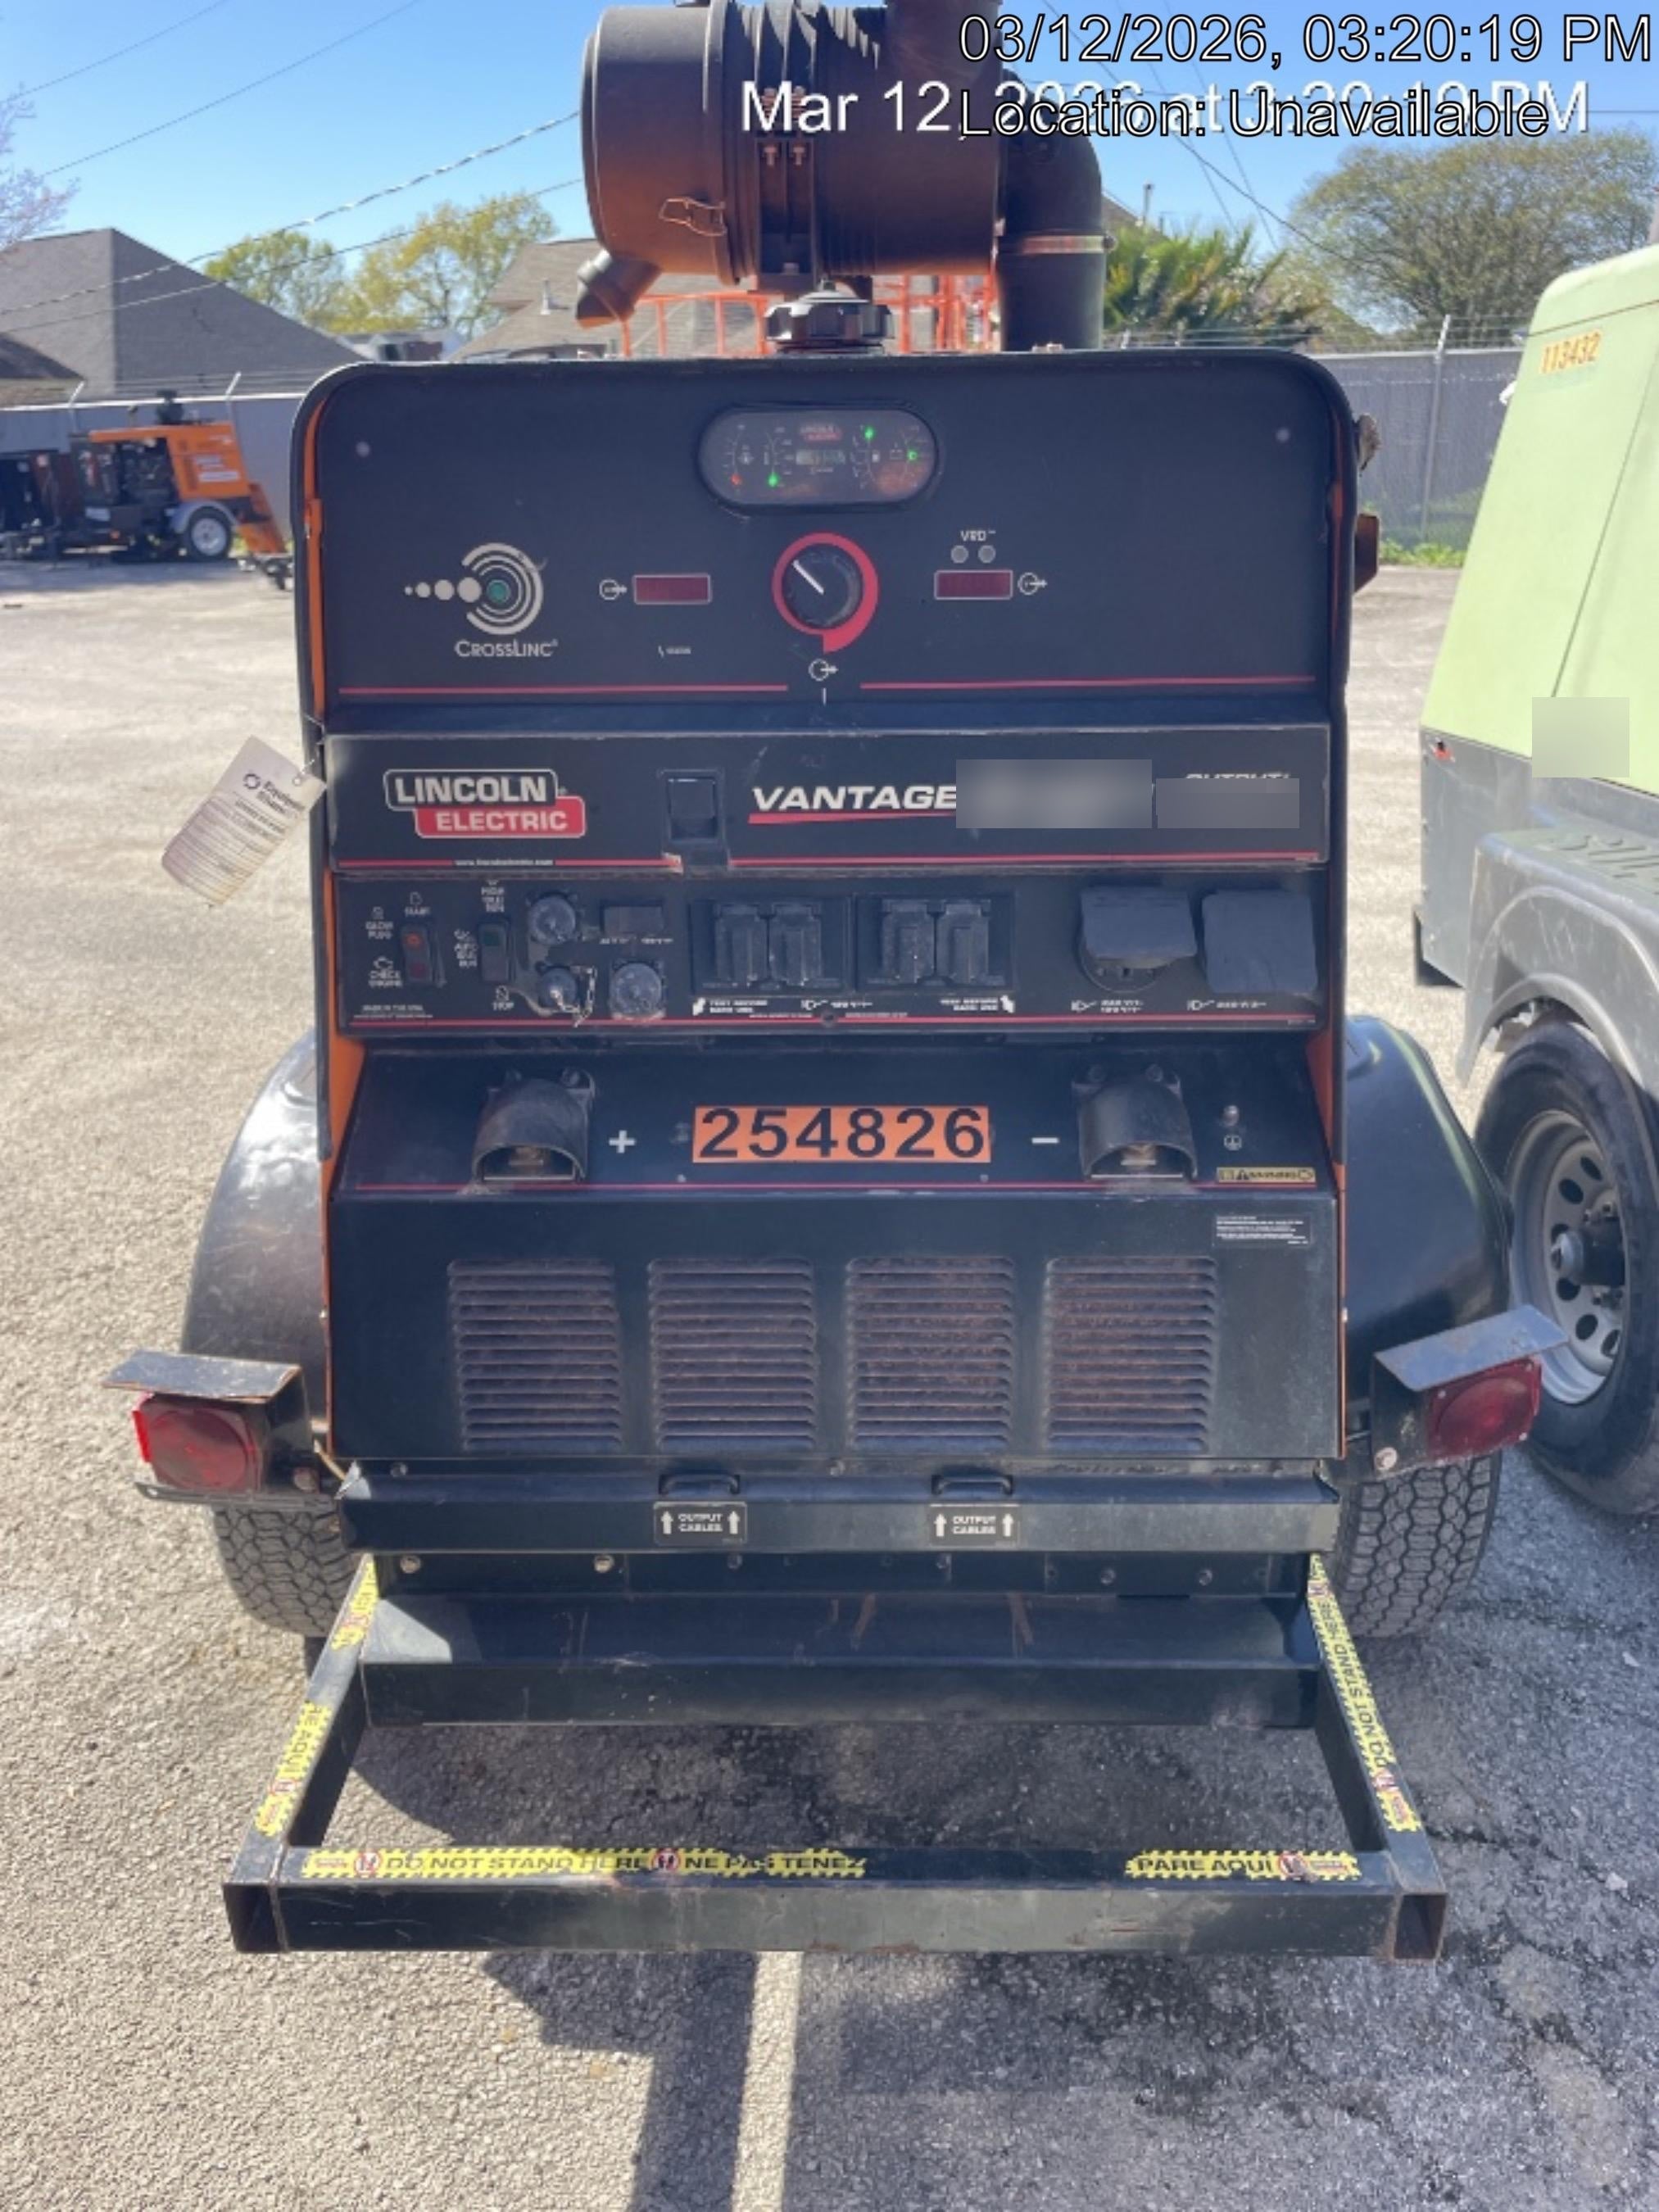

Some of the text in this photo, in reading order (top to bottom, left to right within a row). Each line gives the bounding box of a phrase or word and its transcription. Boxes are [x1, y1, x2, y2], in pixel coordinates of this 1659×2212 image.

[395, 777, 548, 804] LINCOLN
[752, 786, 957, 811] VANTAGE
[436, 811, 568, 831] ELECTRIC
[698, 1107, 985, 1158] 254826
[953, 1516, 996, 1525] OUTPUT
[429, 1857, 484, 1869] NOT
[488, 1857, 574, 1869] STAND
[1136, 1858, 1203, 1871] PARE
